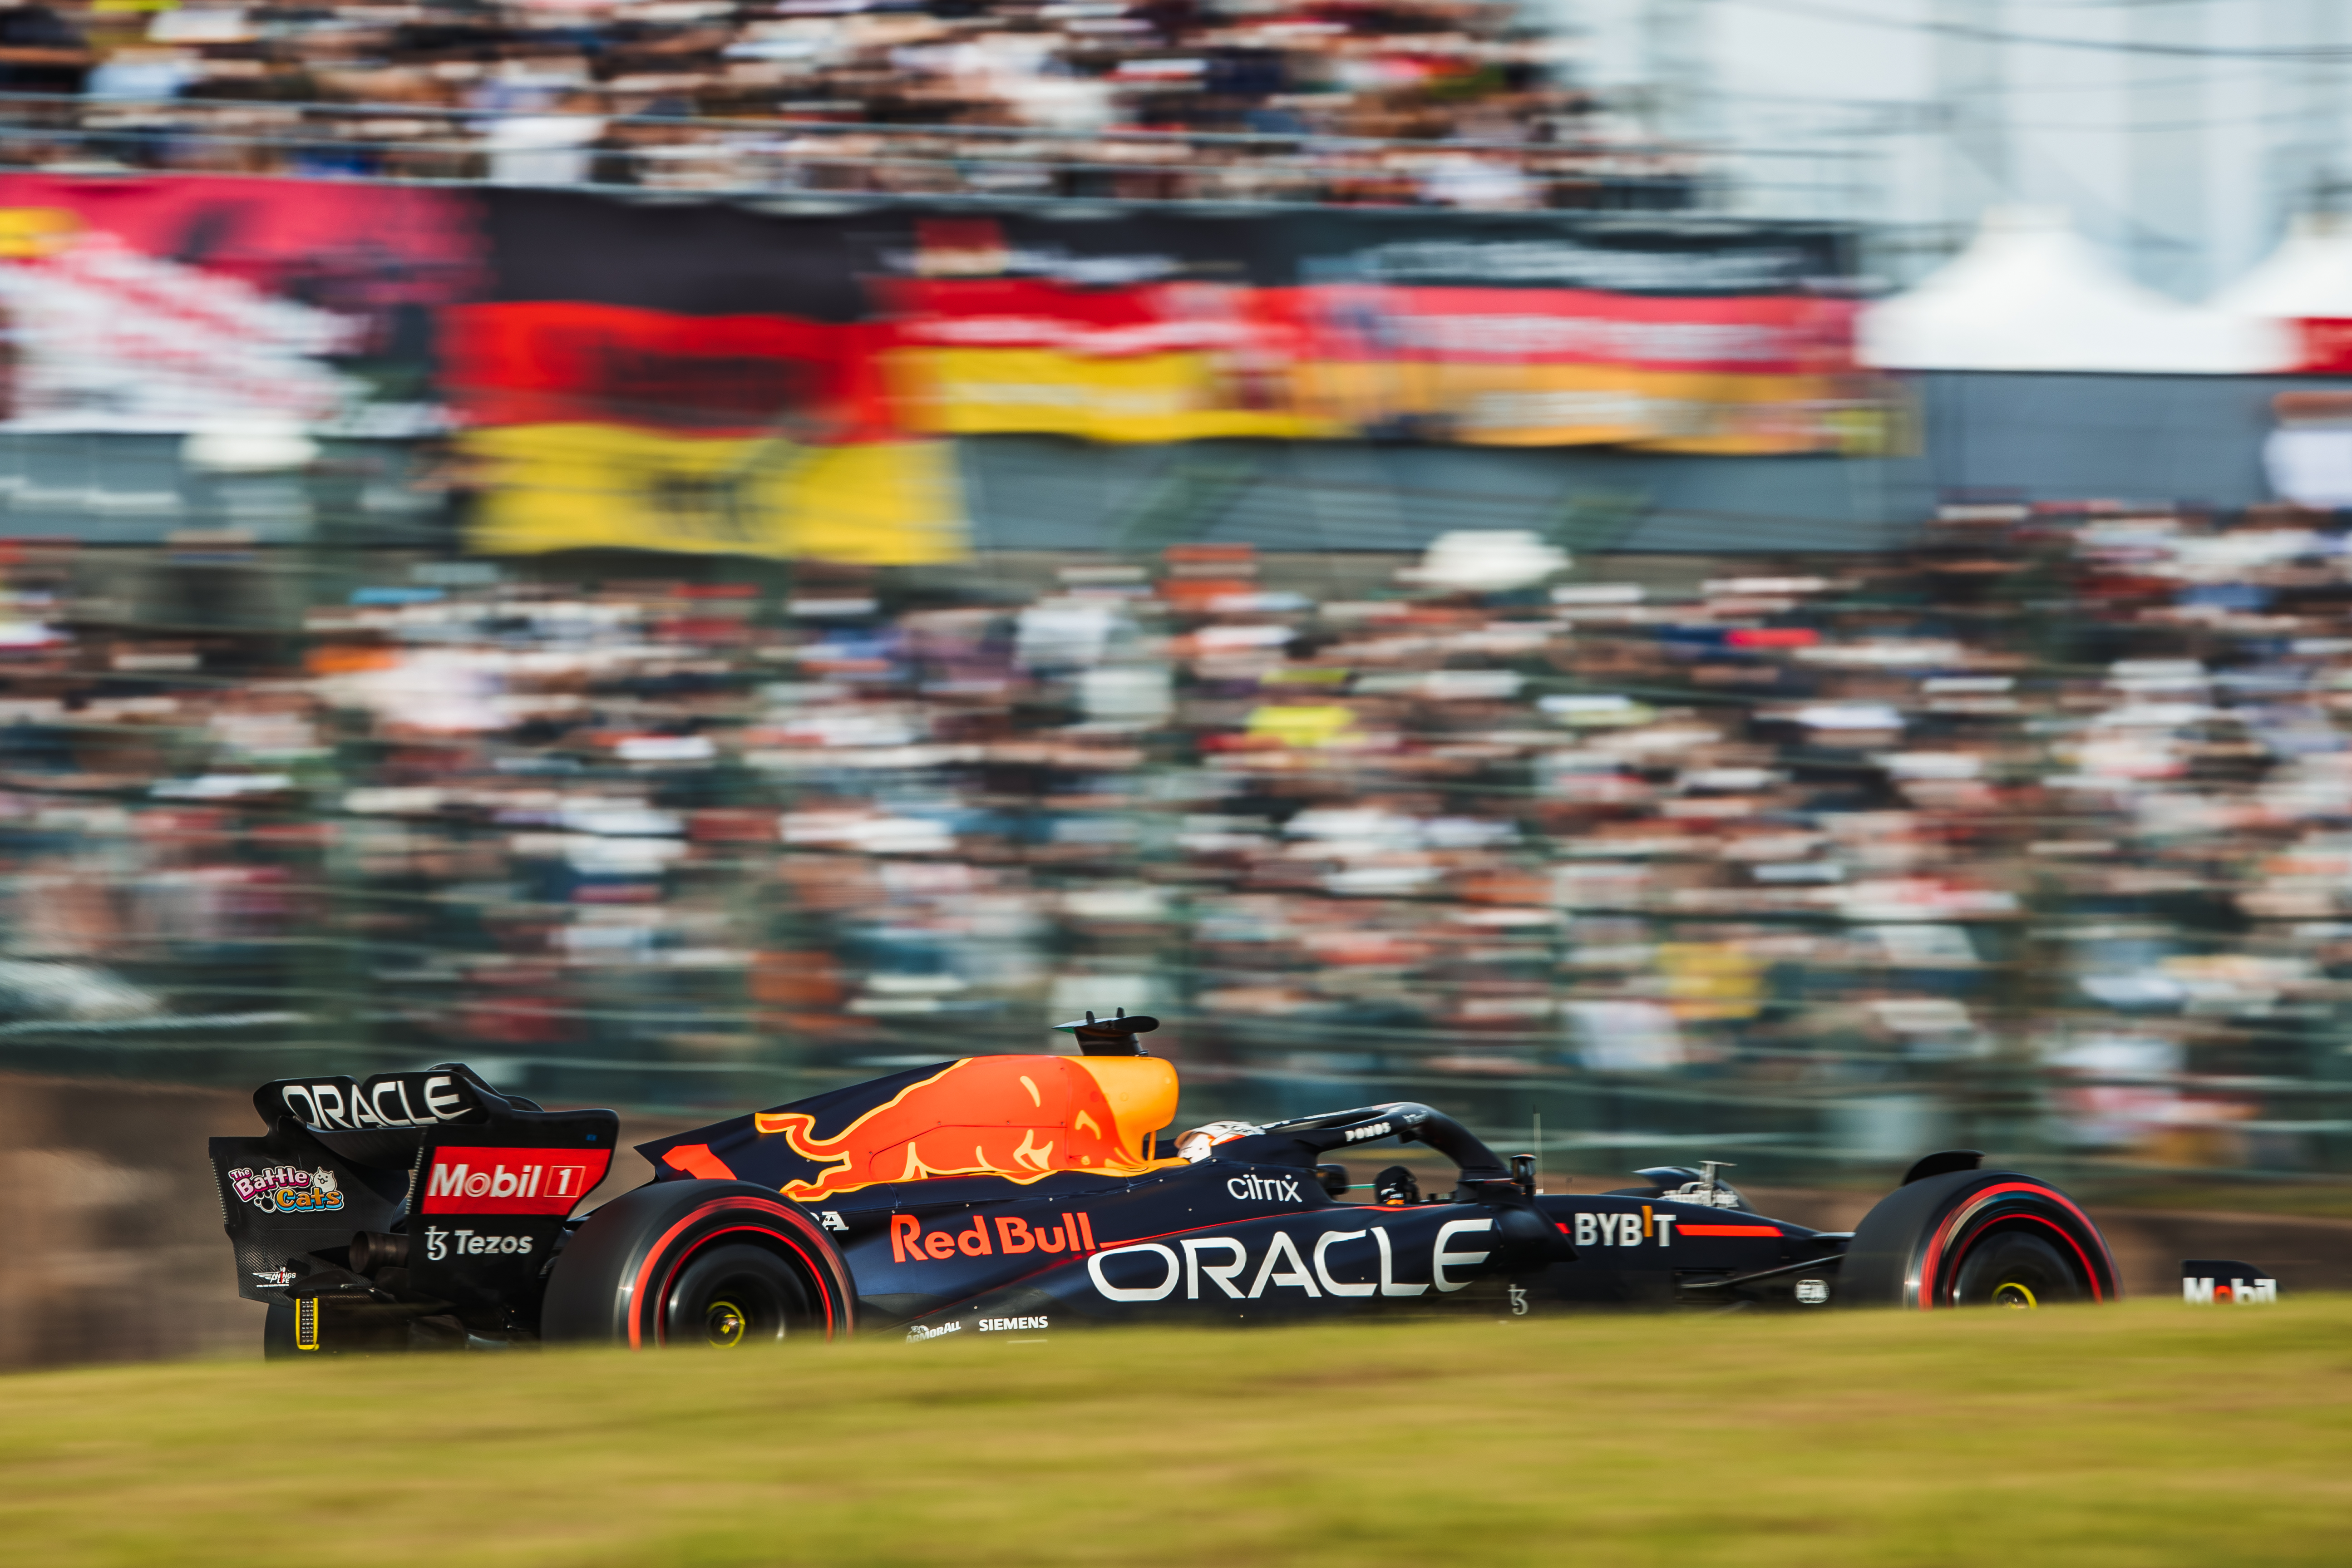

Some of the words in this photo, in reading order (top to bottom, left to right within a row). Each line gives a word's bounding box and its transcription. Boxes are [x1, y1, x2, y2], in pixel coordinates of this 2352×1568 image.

[282, 1076, 473, 1129] ORACLE
[1345, 1122, 1391, 1142] PONOS
[231, 1168, 251, 1179] The
[234, 1167, 309, 1199] Battle
[427, 1164, 543, 1197] Mobil
[276, 1188, 341, 1210] Cats
[1227, 1174, 1302, 1203] citrix
[891, 1214, 992, 1263] Red
[995, 1212, 1095, 1254] Bull
[1575, 1205, 1677, 1247] BYBIT
[454, 1230, 533, 1254] Tezos
[1088, 1218, 1493, 1302] ORACLE
[2183, 1277, 2277, 1305] Mobil
[979, 1316, 1048, 1332] SIEMENS
